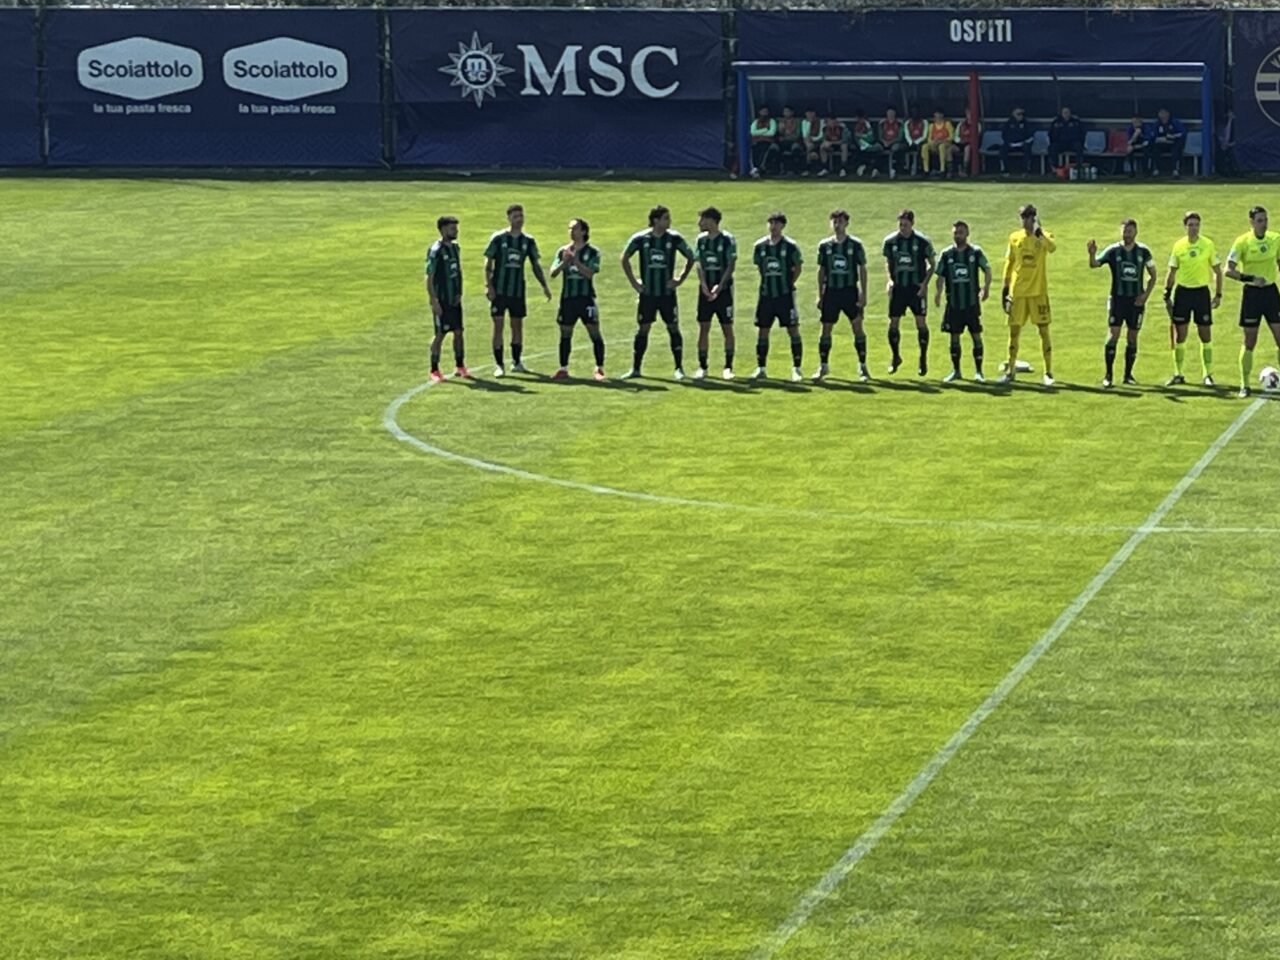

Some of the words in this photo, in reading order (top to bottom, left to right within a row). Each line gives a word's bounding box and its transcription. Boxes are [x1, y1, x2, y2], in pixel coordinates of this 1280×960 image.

[949, 19, 1012, 42] OSPITI
[88, 59, 193, 78] Scoiattolo
[233, 59, 338, 78] Scoiattolo
[516, 44, 681, 99] MSC
[157, 103, 192, 113] fresca
[302, 103, 336, 114] fresca
